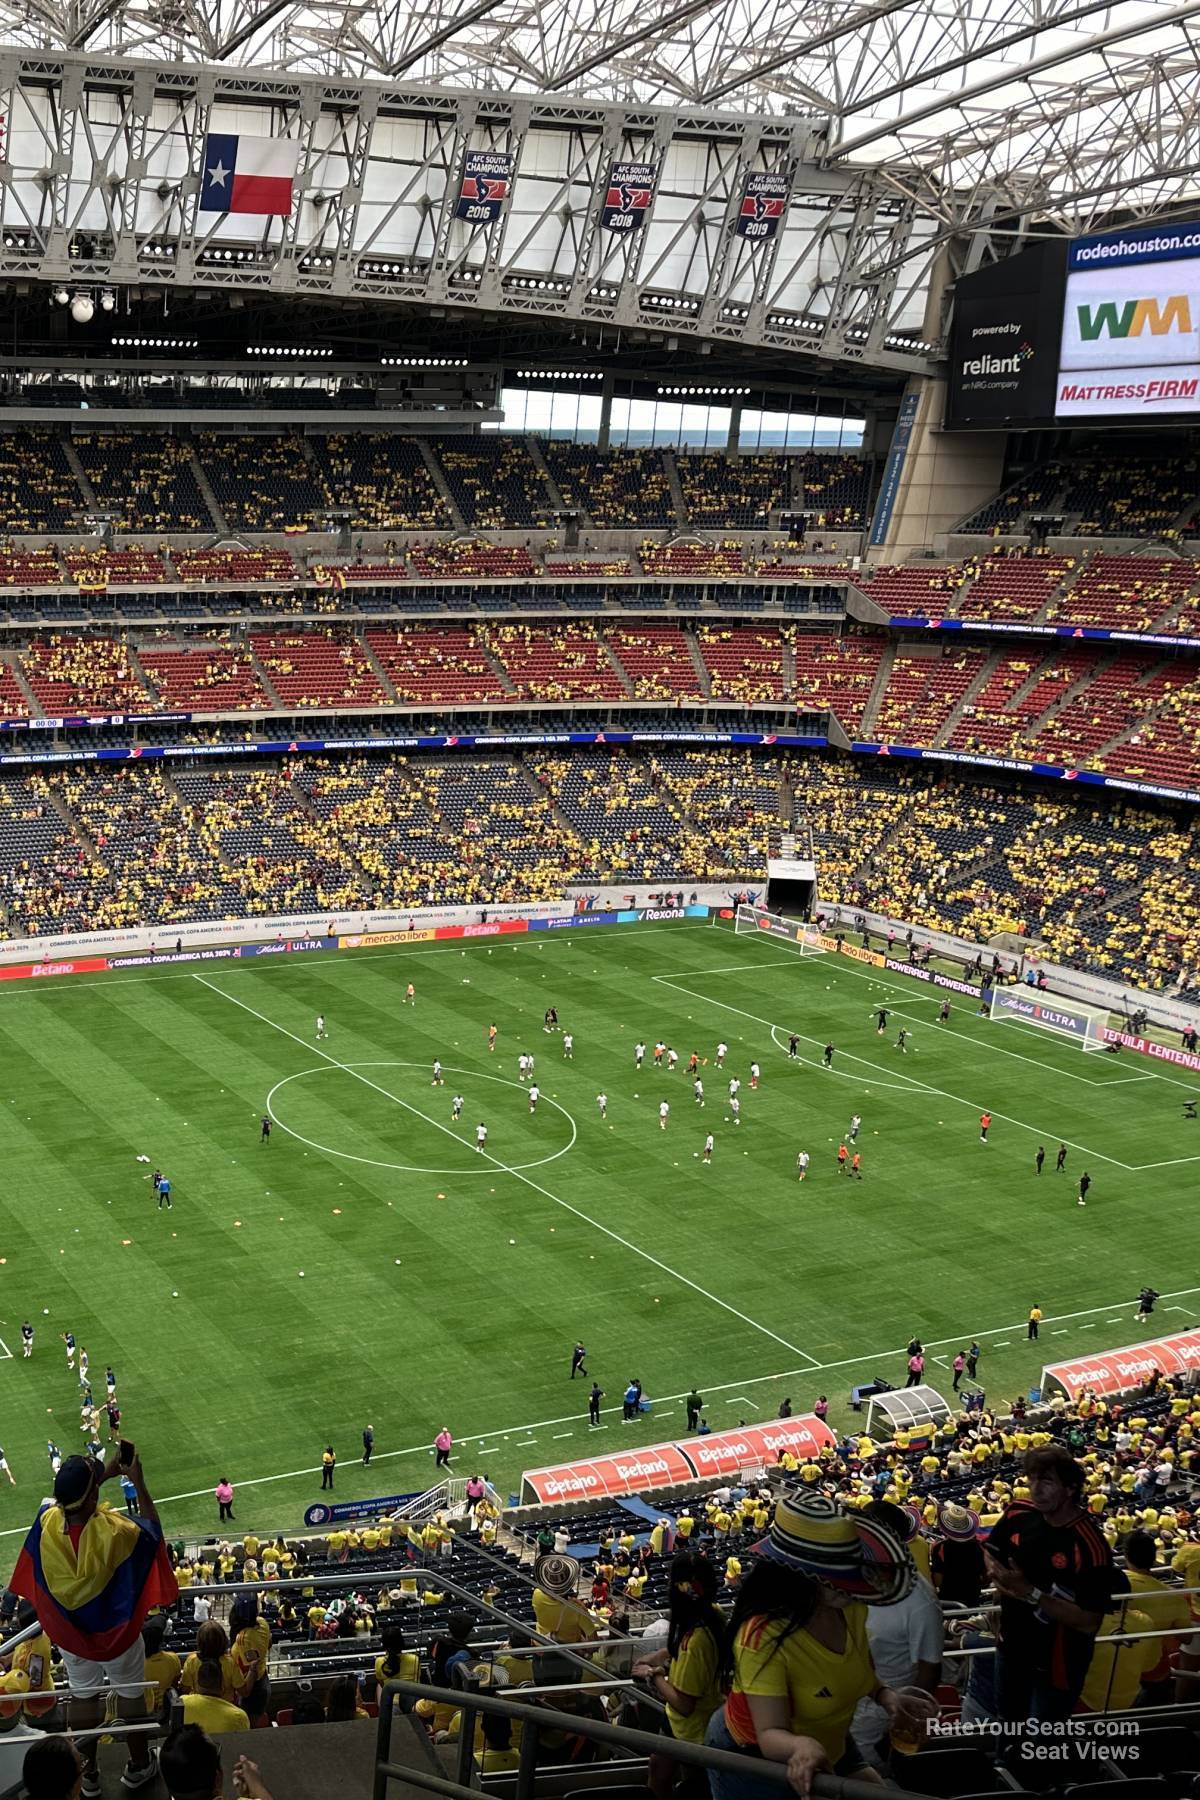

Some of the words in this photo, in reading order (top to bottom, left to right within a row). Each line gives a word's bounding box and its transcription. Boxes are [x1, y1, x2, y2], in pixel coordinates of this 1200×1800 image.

[486, 156, 506, 164] SOUTH
[466, 162, 508, 174] CHAMPIONS
[612, 173, 652, 183] CHAMPIONS
[749, 182, 786, 193] CHAMPIONS
[466, 206, 491, 219] 2016
[609, 214, 633, 227] 2018
[746, 223, 768, 235] 2019
[1077, 294, 1192, 341] WM
[972, 324, 1009, 337] powered
[1010, 323, 1021, 334] by
[962, 354, 1020, 375] reliant
[970, 382, 986, 390] NRG
[987, 381, 1019, 391] company
[974, 757, 1003, 766] AMERICA
[646, 909, 685, 920] Rexona
[464, 924, 500, 936] Betano
[365, 933, 406, 944] mercado
[407, 930, 427, 941] libre
[293, 941, 322, 950] ULTRA
[114, 958, 152, 967] CONMEBOL
[171, 953, 200, 962] AMERICA
[201, 951, 213, 959] USA
[858, 948, 878, 964] libre
[32, 963, 74, 976] Betano
[886, 960, 930, 980] POWERADE
[934, 974, 981, 997] POWERADE
[1041, 1010, 1077, 1028] ULTRA
[1066, 1368, 1110, 1386] Betano
[1117, 1358, 1158, 1376] Betano
[698, 1442, 748, 1463] Betano
[763, 1428, 812, 1450] Betano
[544, 1474, 597, 1496] Betano
[616, 1458, 669, 1479] Betano
